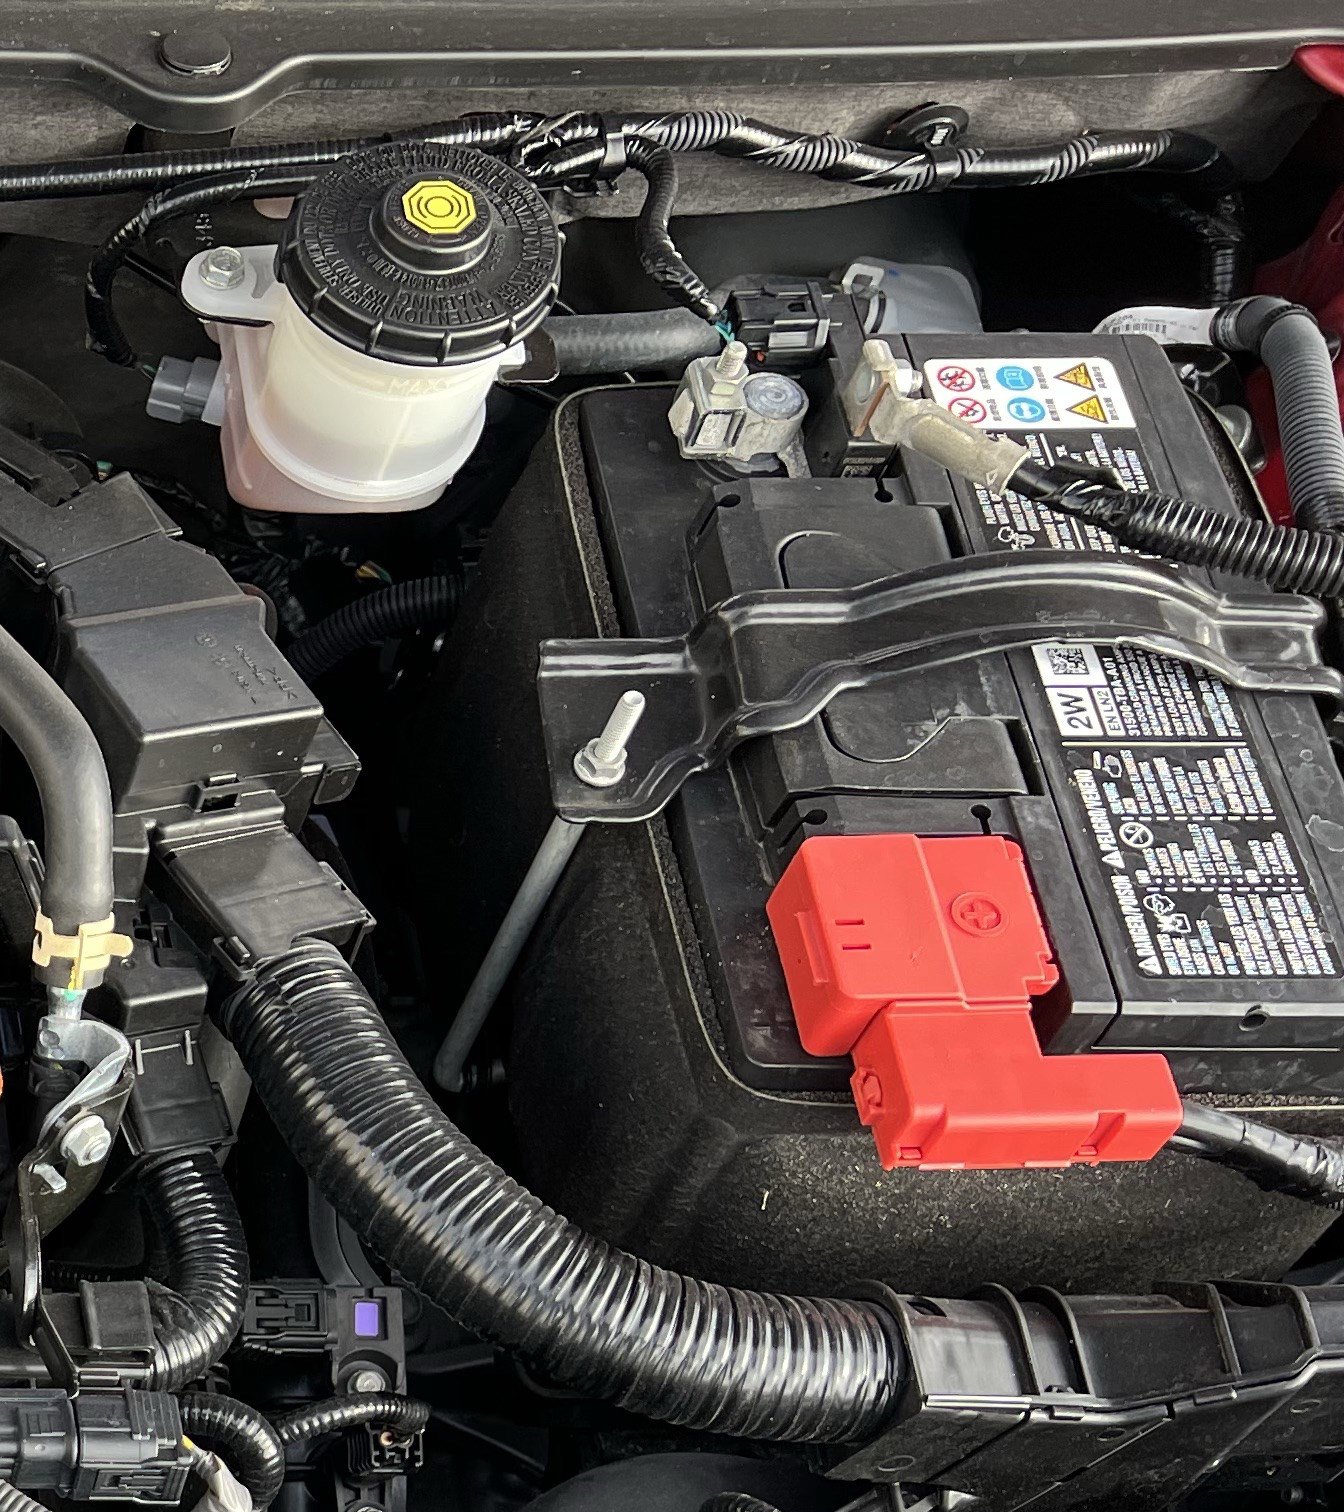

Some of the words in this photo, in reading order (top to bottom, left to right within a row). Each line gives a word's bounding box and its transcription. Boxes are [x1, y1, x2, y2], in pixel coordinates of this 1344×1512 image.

[1055, 692, 1094, 729] 2W
[1096, 690, 1115, 712] LN2
[1105, 715, 1122, 730] EN
[1108, 875, 1158, 955] DANGER/POISON
